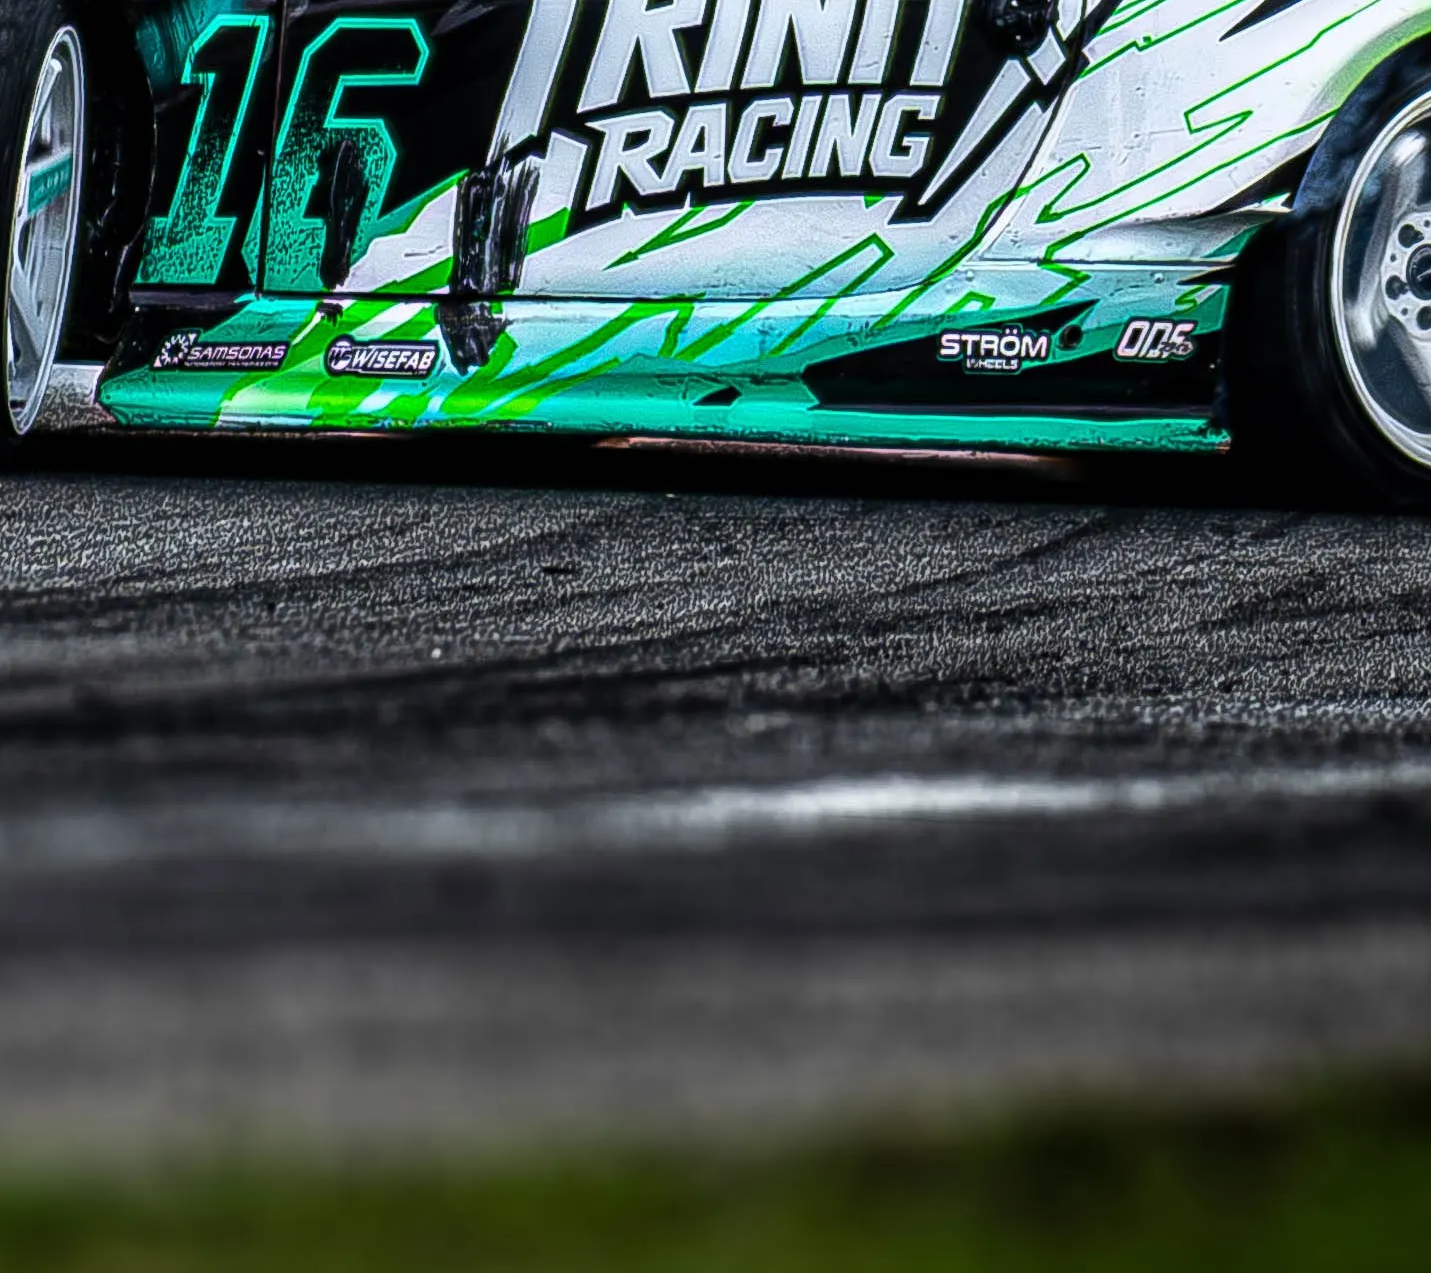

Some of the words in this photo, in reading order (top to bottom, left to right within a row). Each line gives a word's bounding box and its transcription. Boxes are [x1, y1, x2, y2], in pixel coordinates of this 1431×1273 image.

[135, 13, 430, 293] 16
[586, 94, 940, 212] RACING
[187, 345, 286, 360] SAMSONAS
[939, 327, 1048, 359] STRÖM
[352, 348, 436, 370] WISEFAB
[966, 358, 1018, 370] WHEELS
